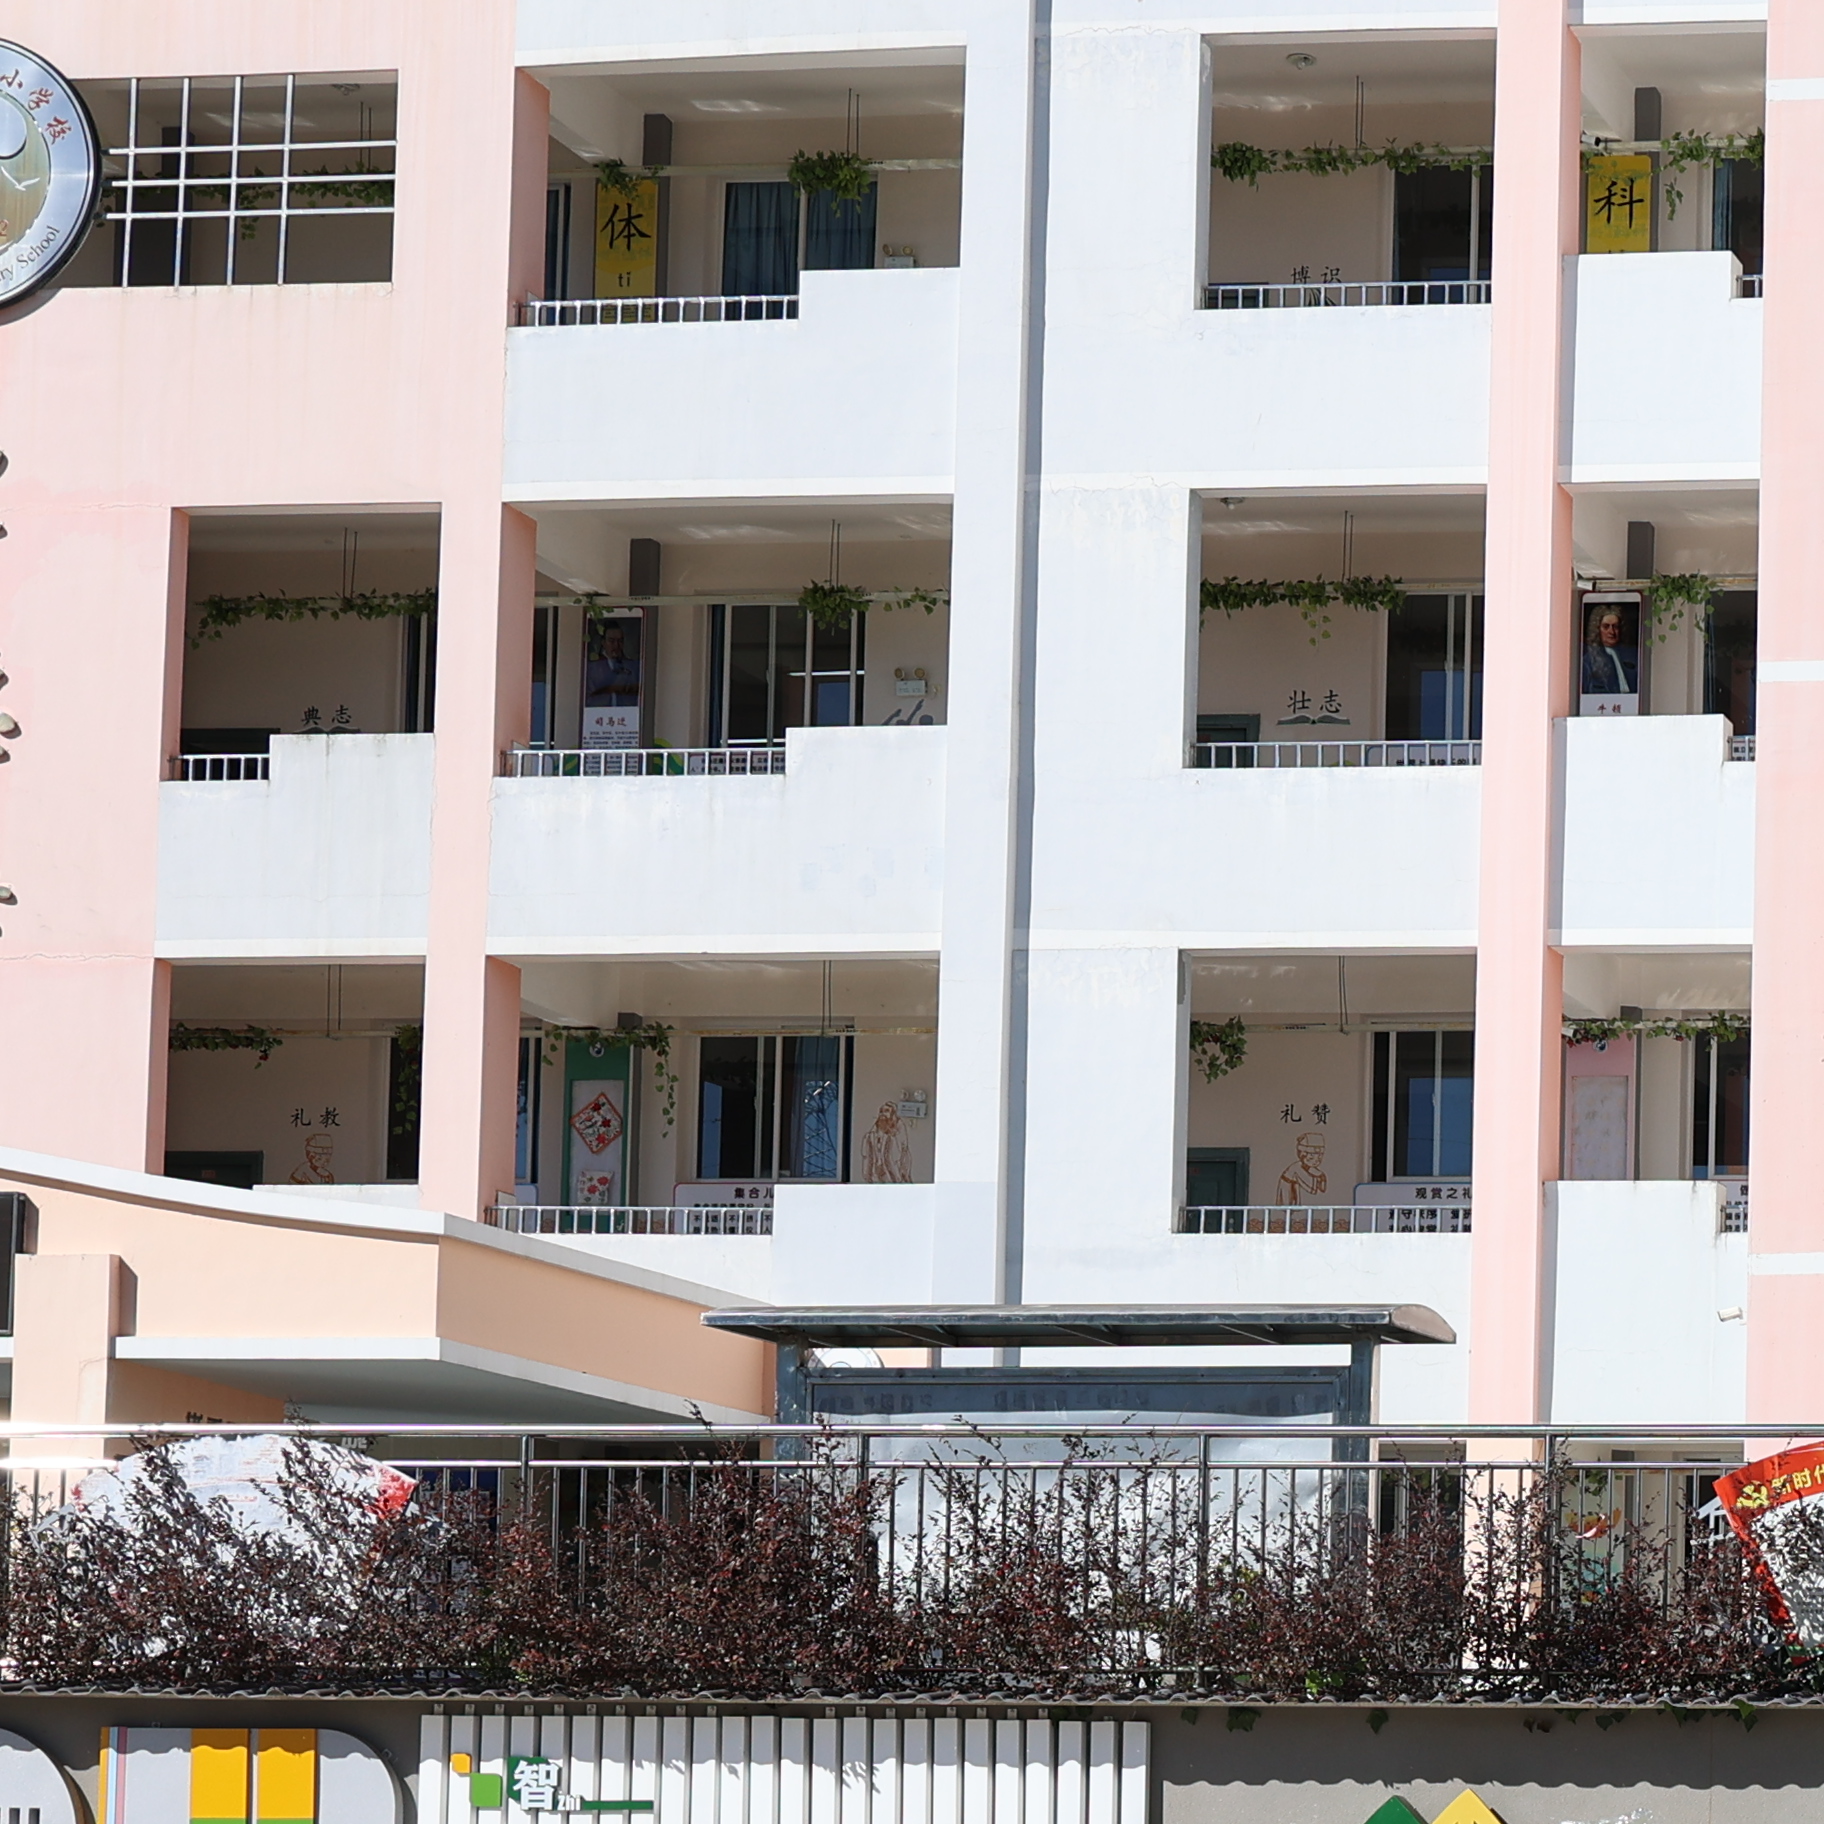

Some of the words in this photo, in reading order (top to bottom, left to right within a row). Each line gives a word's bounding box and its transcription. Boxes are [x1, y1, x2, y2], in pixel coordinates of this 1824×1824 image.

[1593, 178, 1645, 229] 科
[16, 225, 60, 269] School
[600, 202, 652, 252] 体
[1287, 689, 1342, 714] 壮志
[290, 1107, 341, 1128] 礼教
[1280, 1103, 1331, 1125] 礼赞
[513, 1760, 561, 1811] 智
